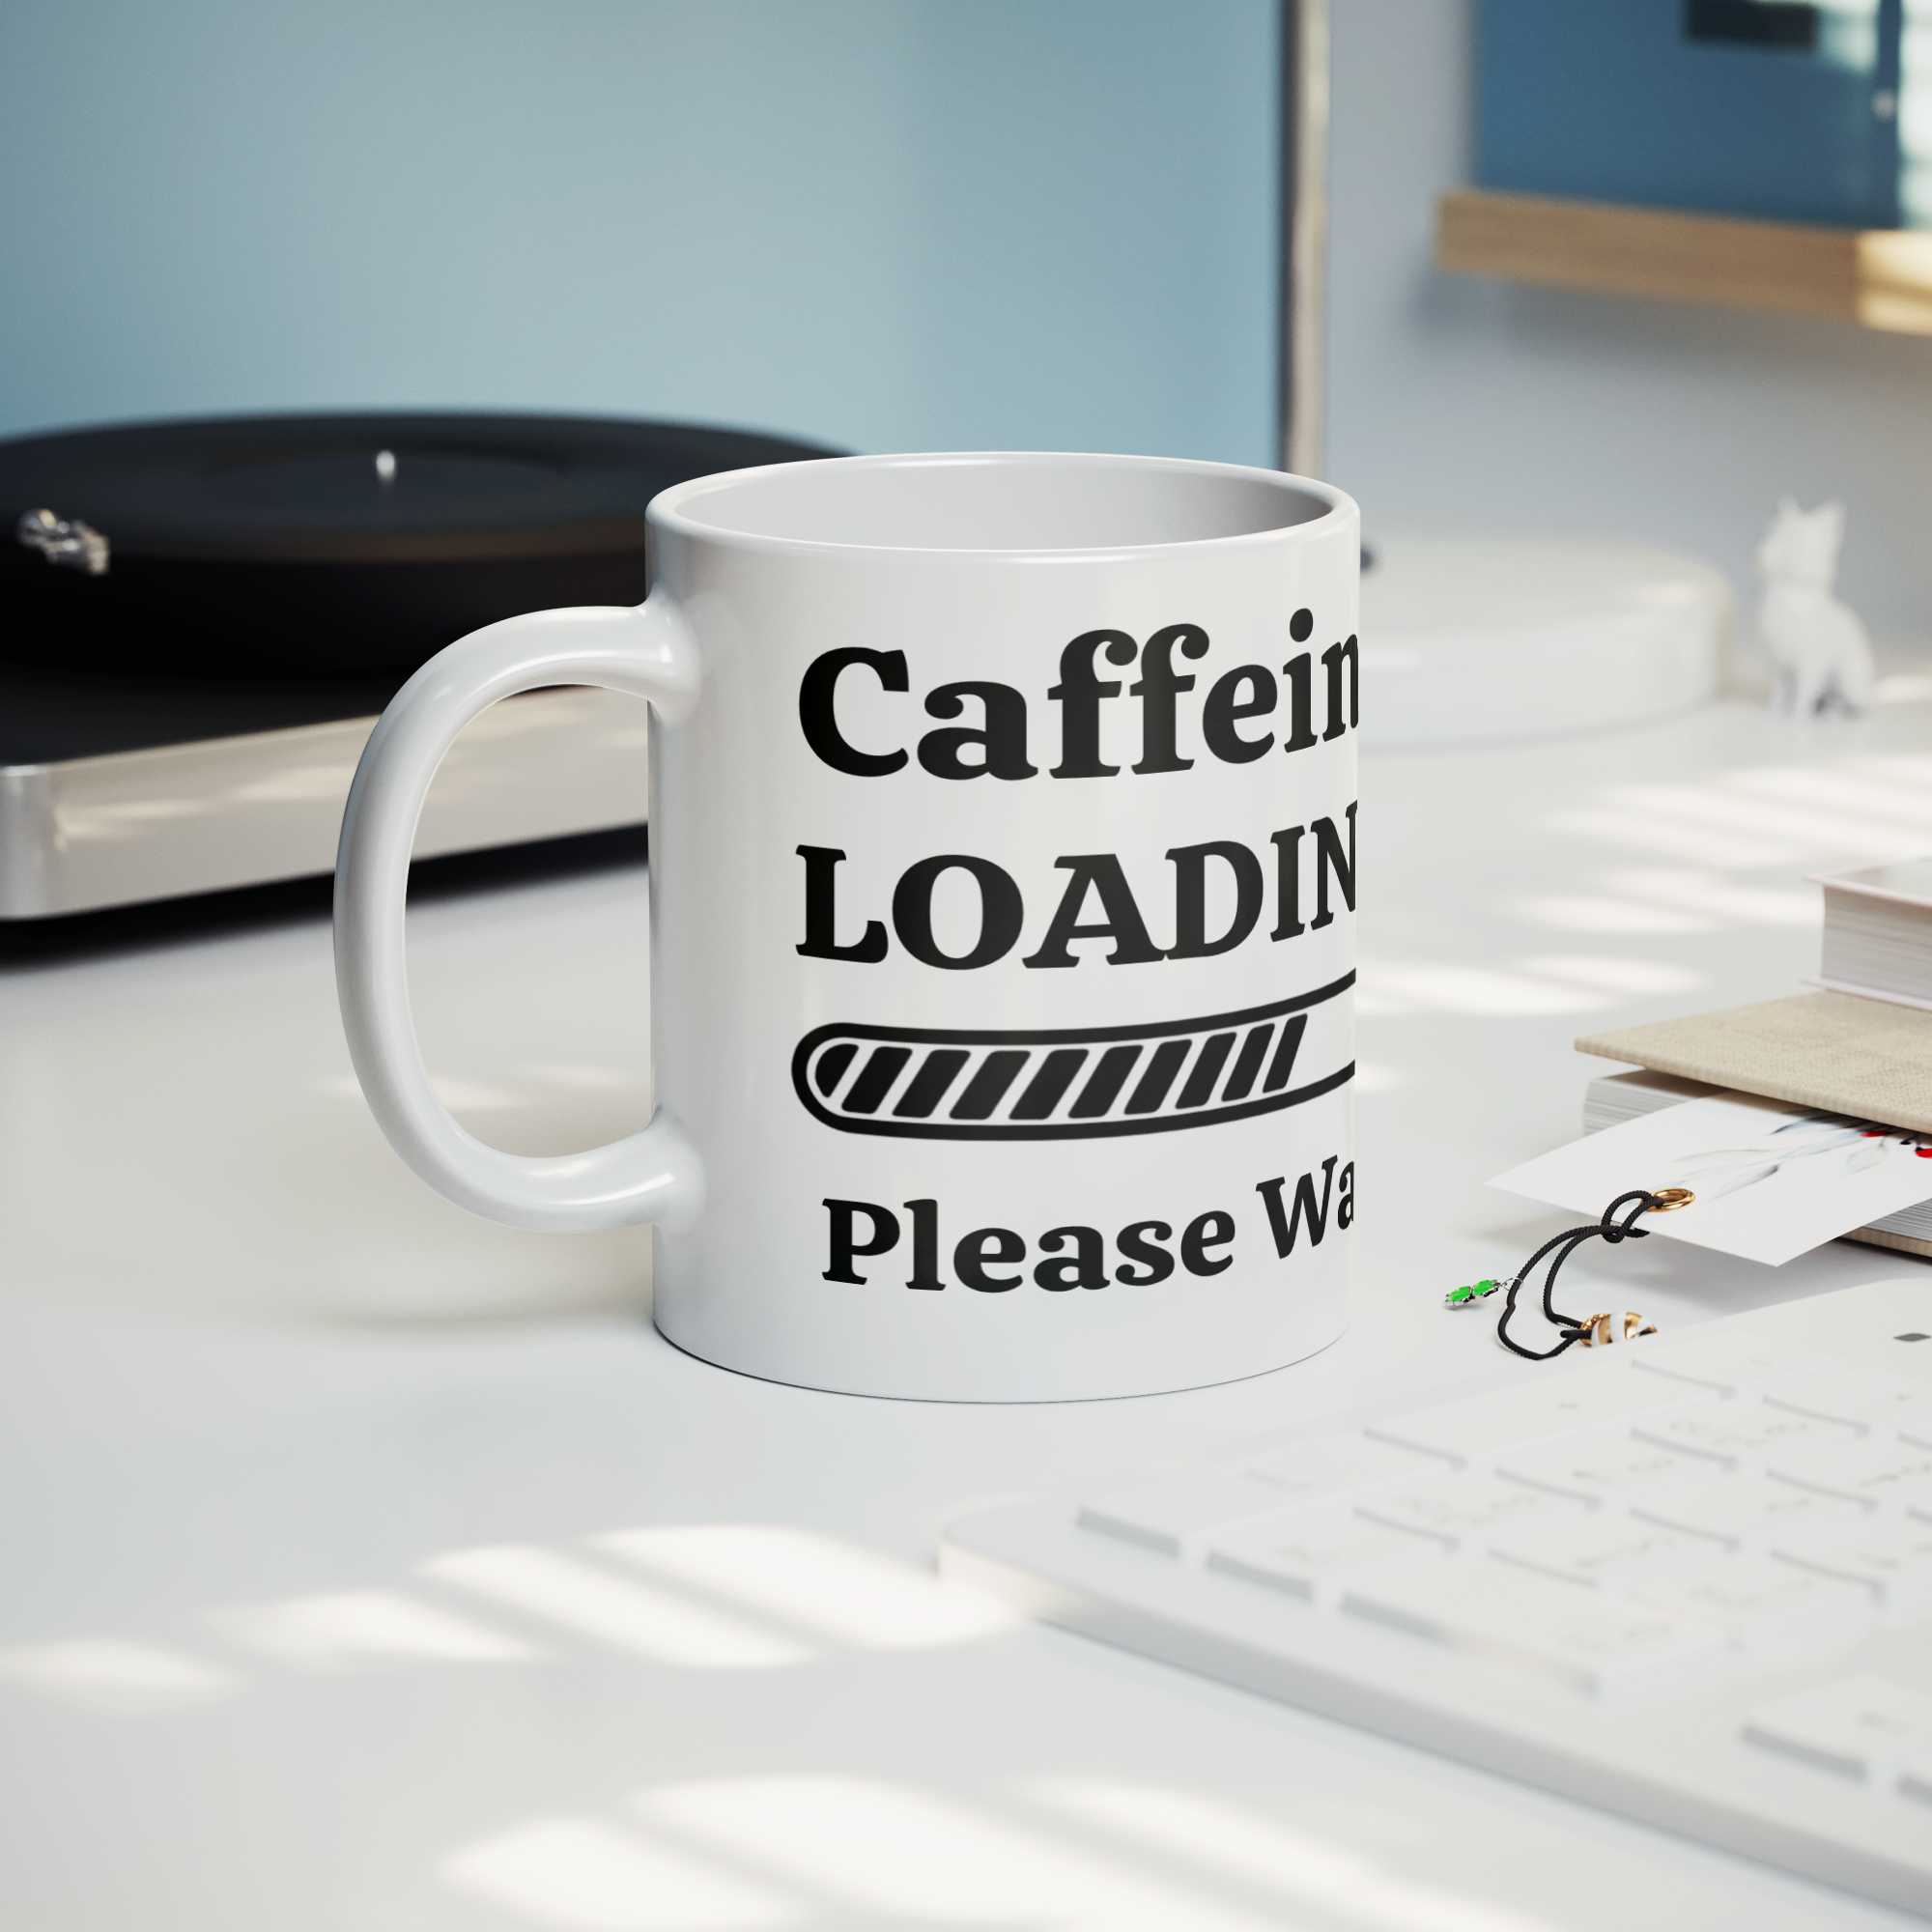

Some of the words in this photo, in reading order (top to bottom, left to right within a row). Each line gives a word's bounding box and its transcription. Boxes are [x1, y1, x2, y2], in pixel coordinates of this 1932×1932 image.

[799, 609, 1358, 781] Caffein
[796, 800, 1357, 970] LOADIN
[822, 1199, 1235, 1293] Please
